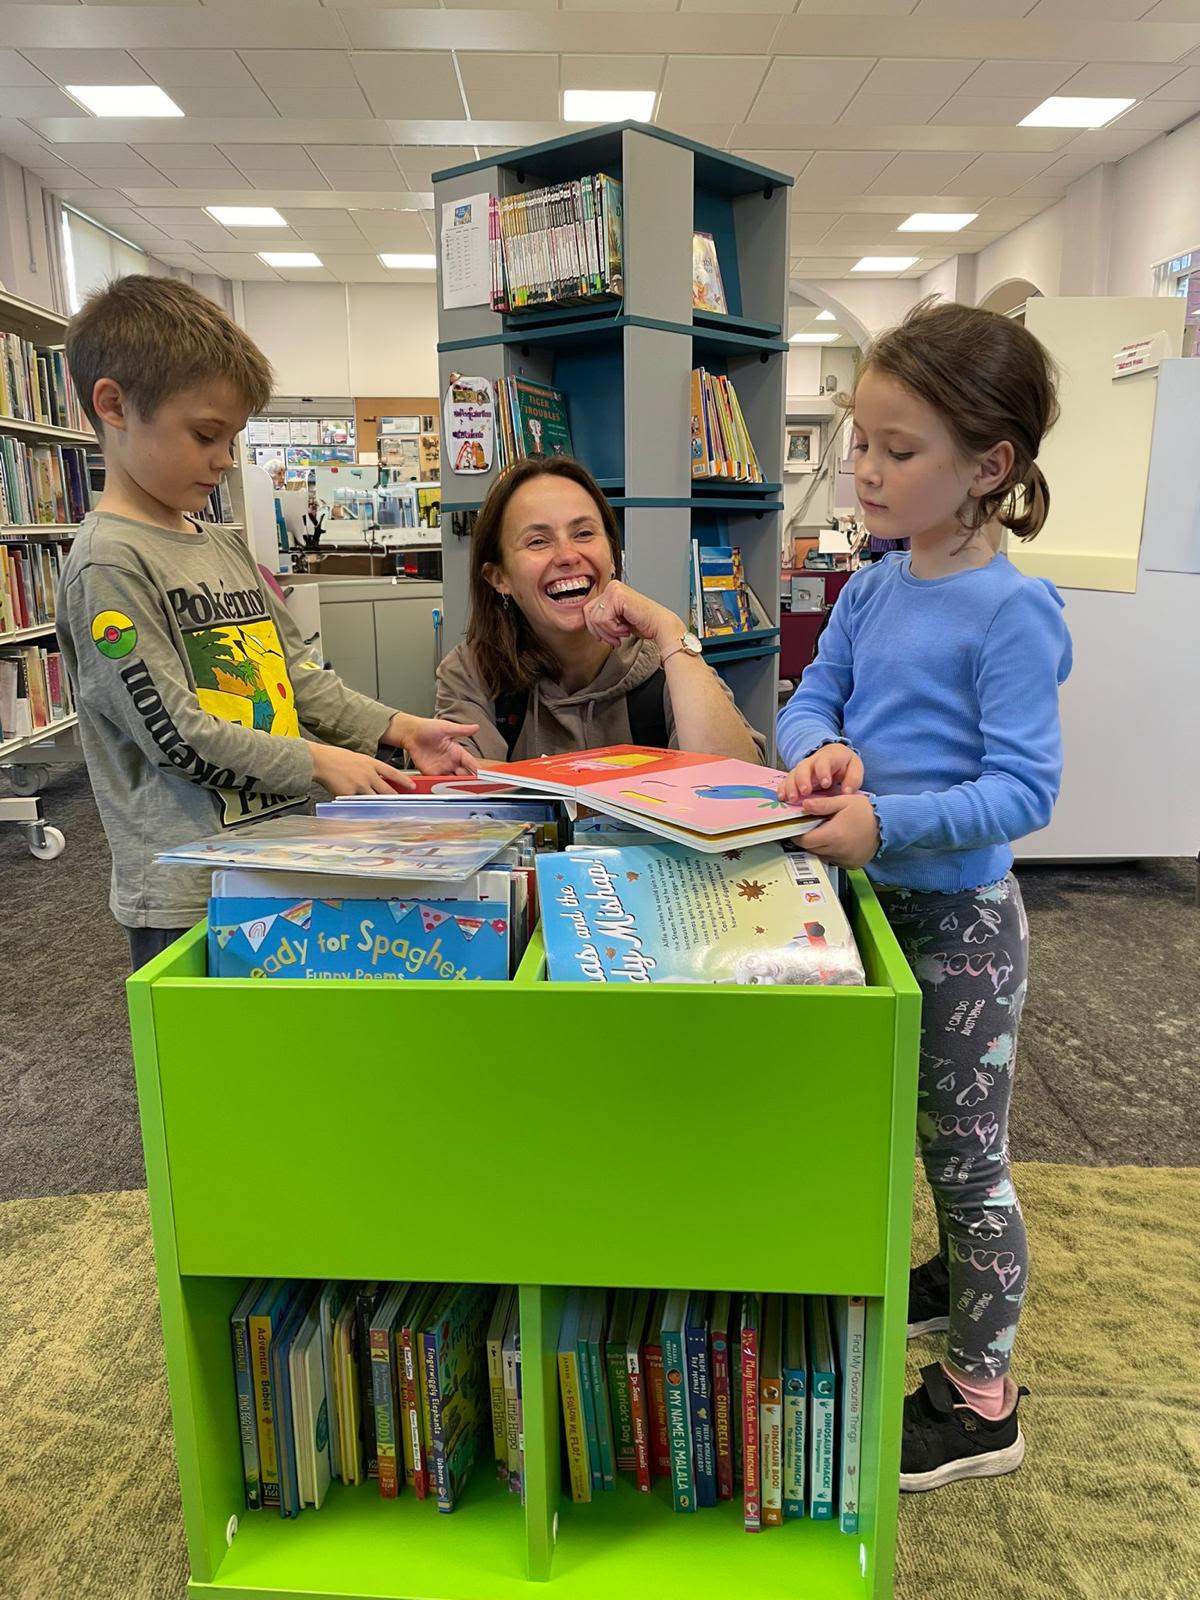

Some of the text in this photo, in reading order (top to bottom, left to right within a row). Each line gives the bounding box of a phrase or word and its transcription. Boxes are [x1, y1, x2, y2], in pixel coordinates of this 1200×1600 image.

[523, 406, 561, 420] TROUBLES
[529, 395, 550, 408] TIGER
[199, 845, 397, 867] COLOUR
[705, 862, 713, 870] just
[656, 859, 664, 877] allowed
[709, 871, 718, 891] everyone
[721, 881, 729, 898] diggers
[555, 884, 580, 907] the
[570, 856, 643, 949] Mishap!
[726, 899, 734, 914] useful
[559, 909, 591, 938] and
[709, 910, 717, 928] engine
[318, 932, 350, 952] for
[670, 922, 678, 940] Steam
[682, 926, 690, 950] because
[691, 921, 700, 944] Thomas
[257, 1328, 270, 1411] Adventure Babies
[744, 1360, 756, 1378] Play
[425, 1348, 441, 1434] Fingerwiggly Elephants
[630, 1376, 638, 1386] Dr.
[746, 1380, 756, 1397] Hide
[847, 1334, 862, 1443] Find My Favourite Things
[492, 1387, 504, 1409] Little
[507, 1398, 517, 1421] Little
[566, 1397, 576, 1422] FOLLOW
[616, 1370, 631, 1443] St Patrick's Day
[239, 1394, 253, 1444] DINO EGG HUNT
[376, 1404, 390, 1443] WOODS
[493, 1411, 504, 1438] Hippo
[657, 1406, 667, 1425] New
[746, 1405, 756, 1422] Seek
[507, 1423, 518, 1449] Hippo
[634, 1418, 643, 1443] Amazing
[717, 1395, 728, 1456] CINDERELLA
[669, 1390, 688, 1490] MY NAME IS MALALA
[794, 1411, 803, 1487] DINOSAUR MUNCH!
[822, 1413, 832, 1488] DINOSAUR WHACK!
[746, 1445, 757, 1486] Dinosaurs
[771, 1425, 779, 1489] DINOSAUR BOO!
[436, 1458, 445, 1484] Usborne
